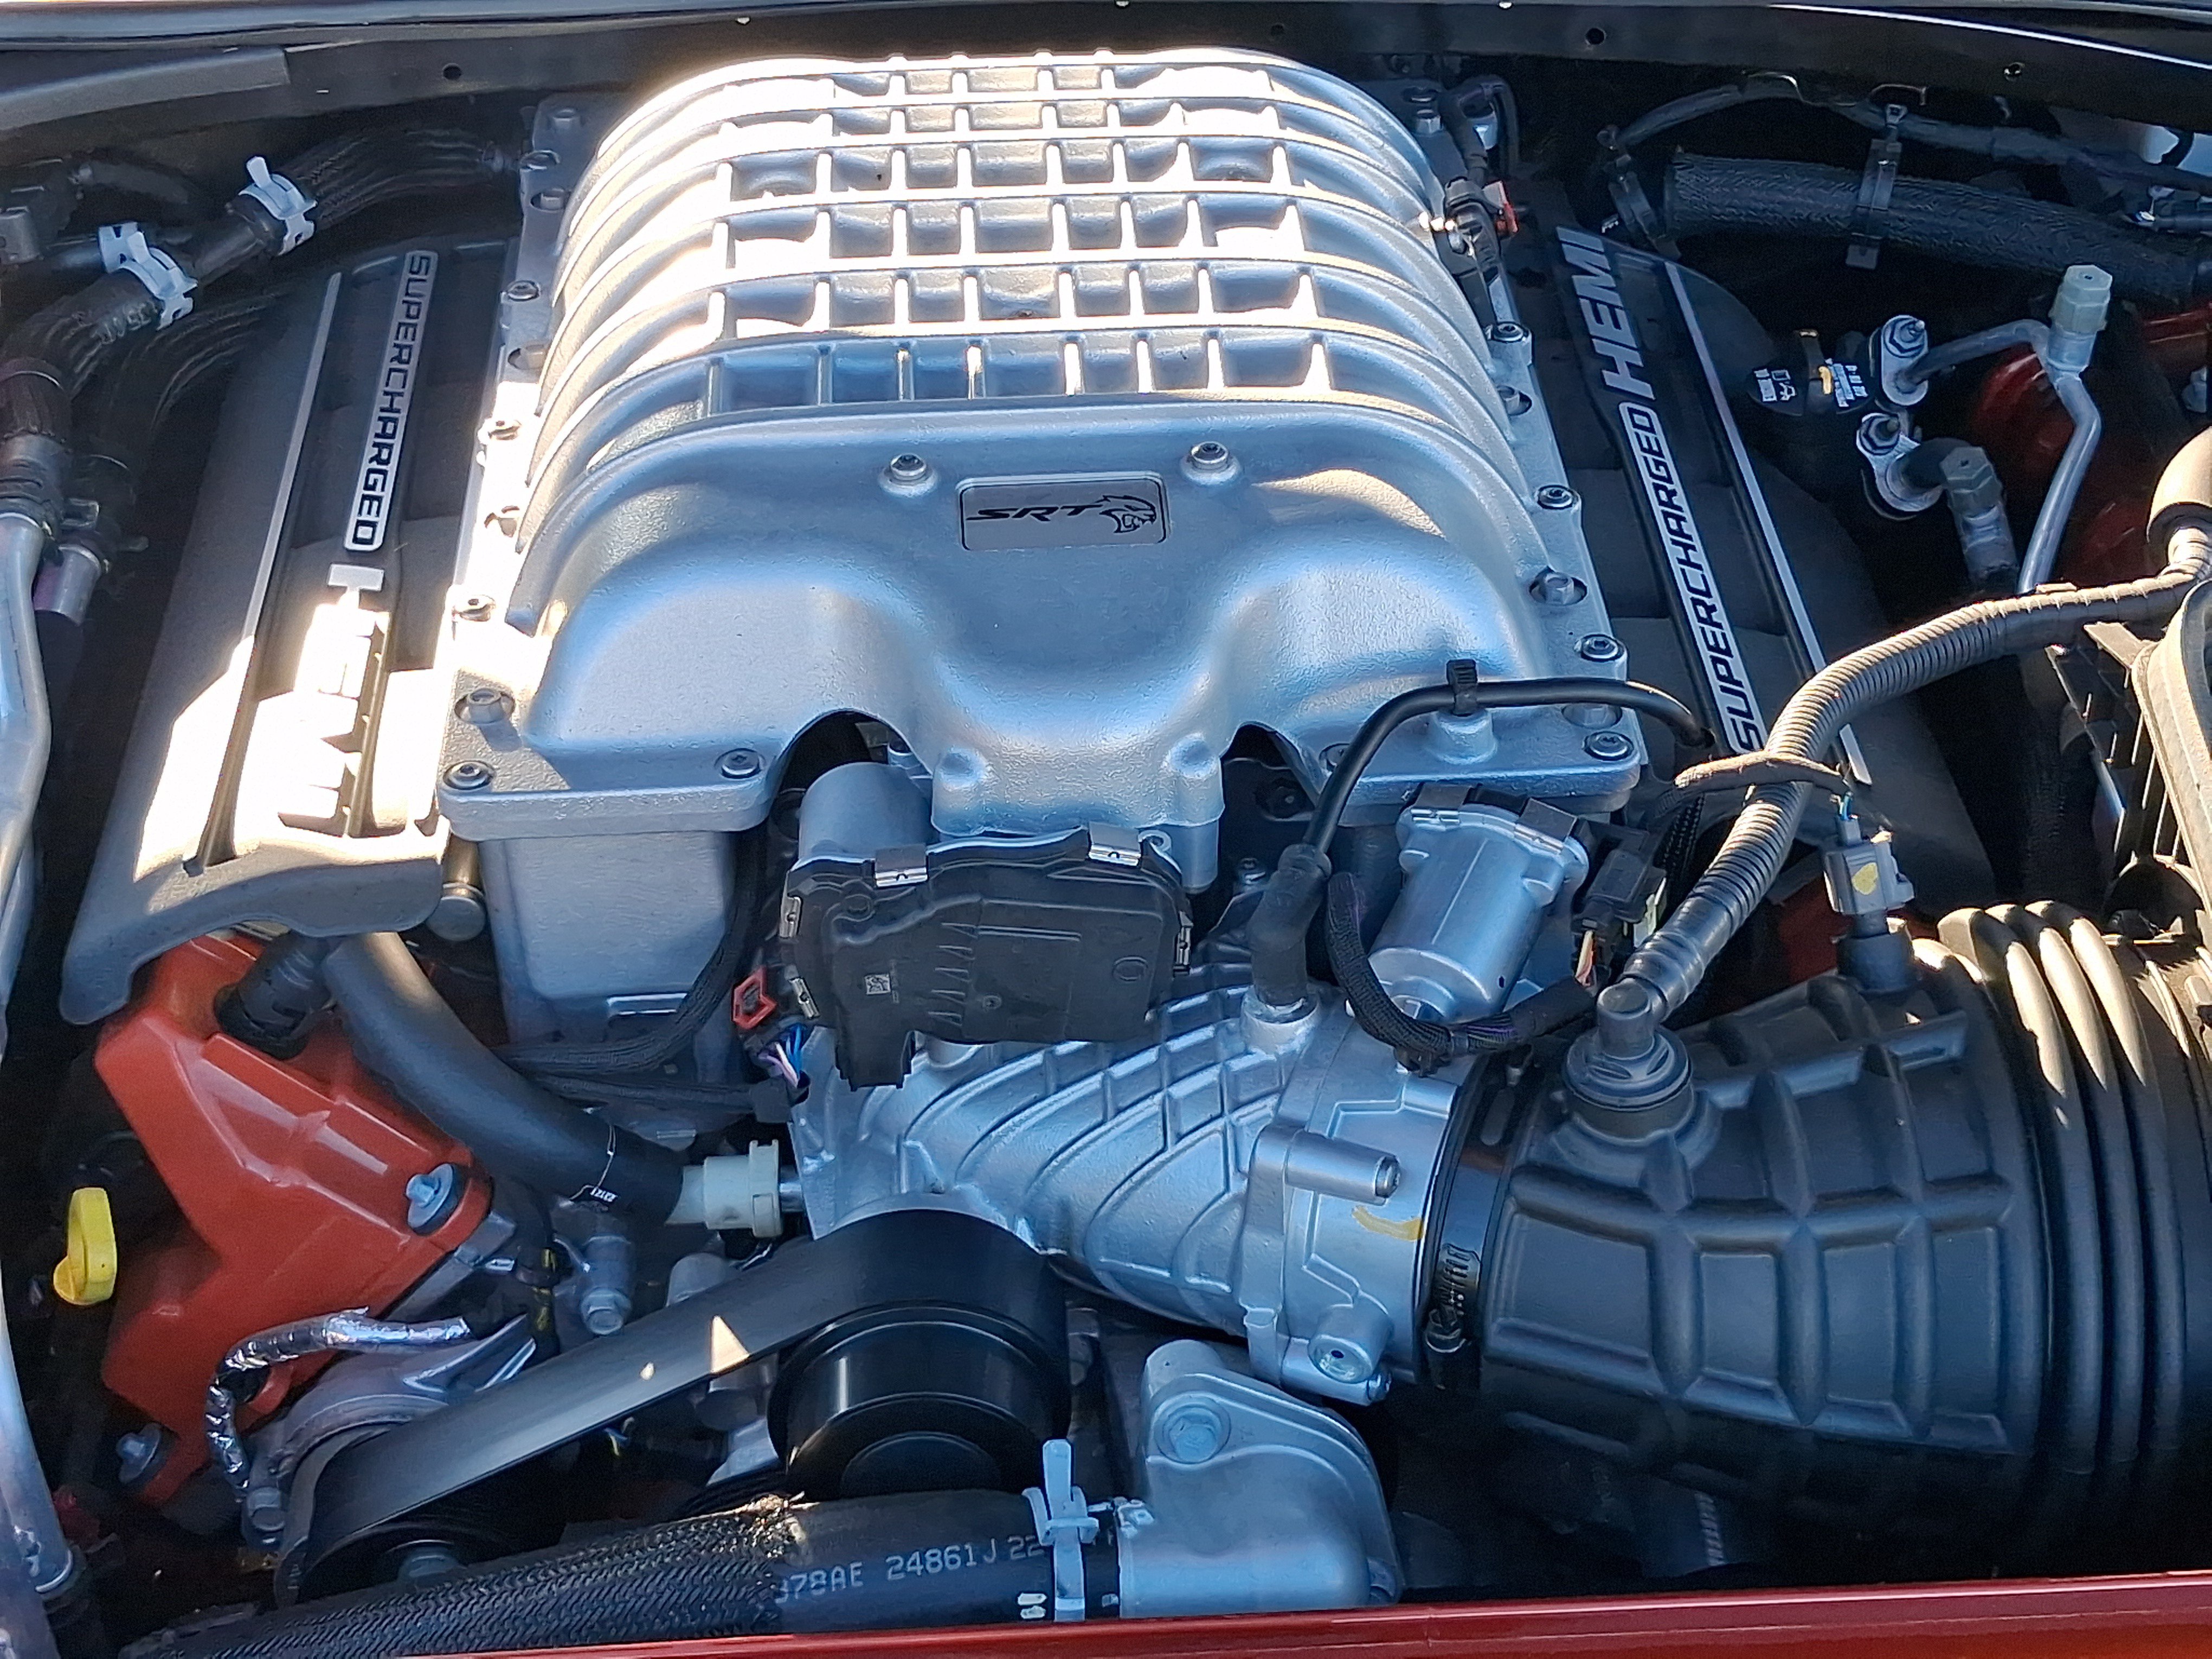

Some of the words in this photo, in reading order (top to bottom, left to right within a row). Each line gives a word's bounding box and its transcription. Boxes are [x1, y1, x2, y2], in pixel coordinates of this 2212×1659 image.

[352, 254, 432, 545] SUPERCHARGED
[1556, 227, 1656, 401] HEMI
[966, 505, 1103, 522] SRT
[1628, 407, 1765, 753] SUPERCHARGED
